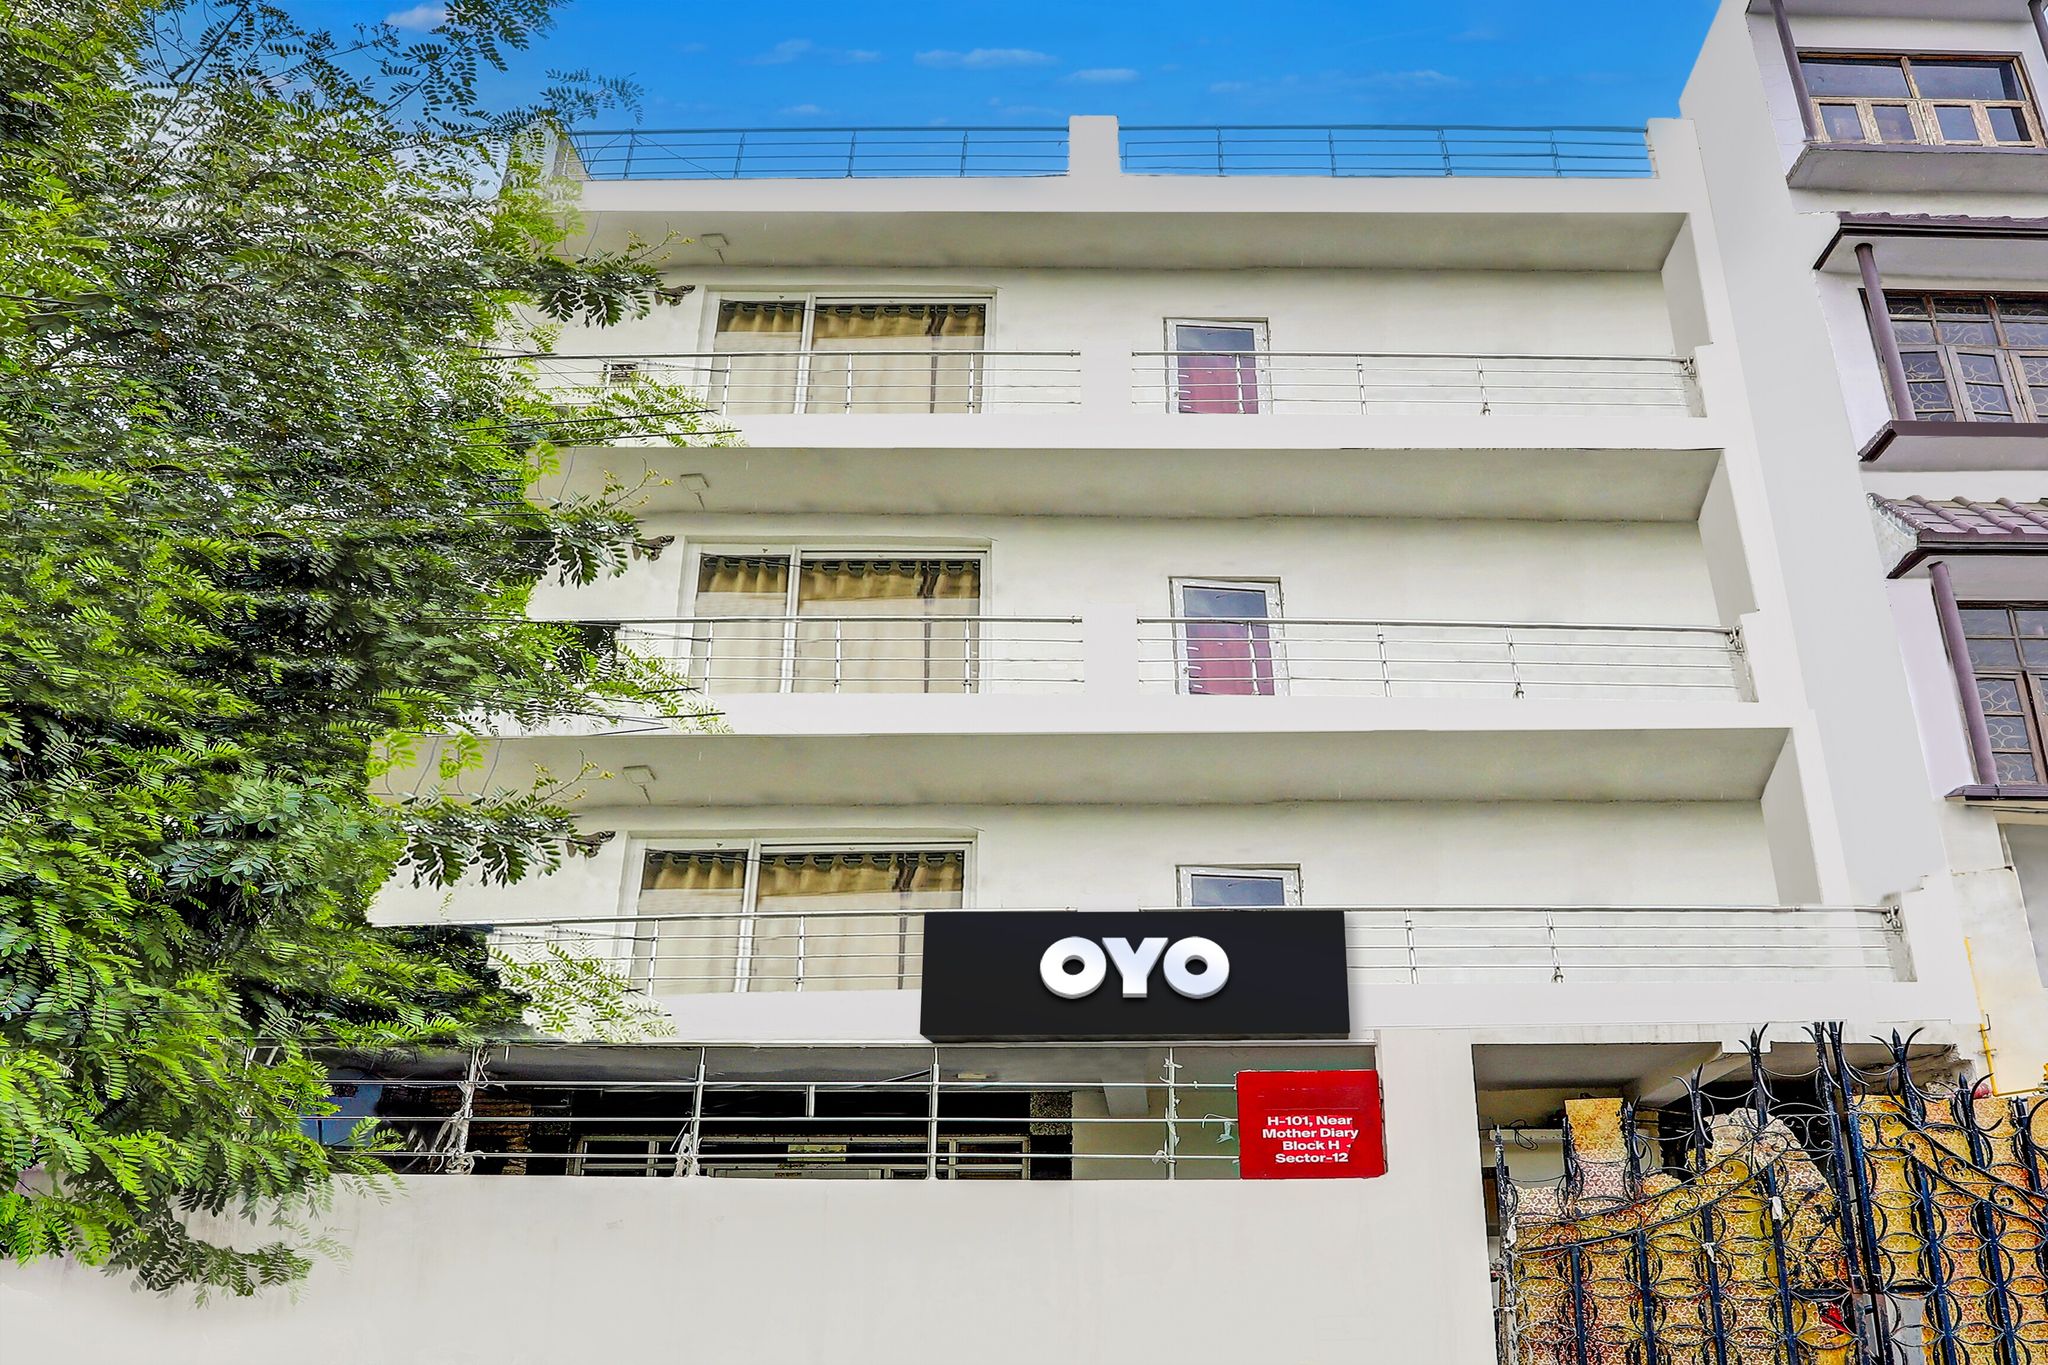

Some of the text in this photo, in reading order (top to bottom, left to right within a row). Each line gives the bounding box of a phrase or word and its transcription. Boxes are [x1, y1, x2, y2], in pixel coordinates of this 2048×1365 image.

[1039, 936, 1230, 999] OYO
[1267, 1115, 1353, 1127] H-101, Near
[1262, 1128, 1359, 1140] Mother Diary
[1282, 1140, 1340, 1151] Block H
[1275, 1152, 1349, 1163] Sector-12
